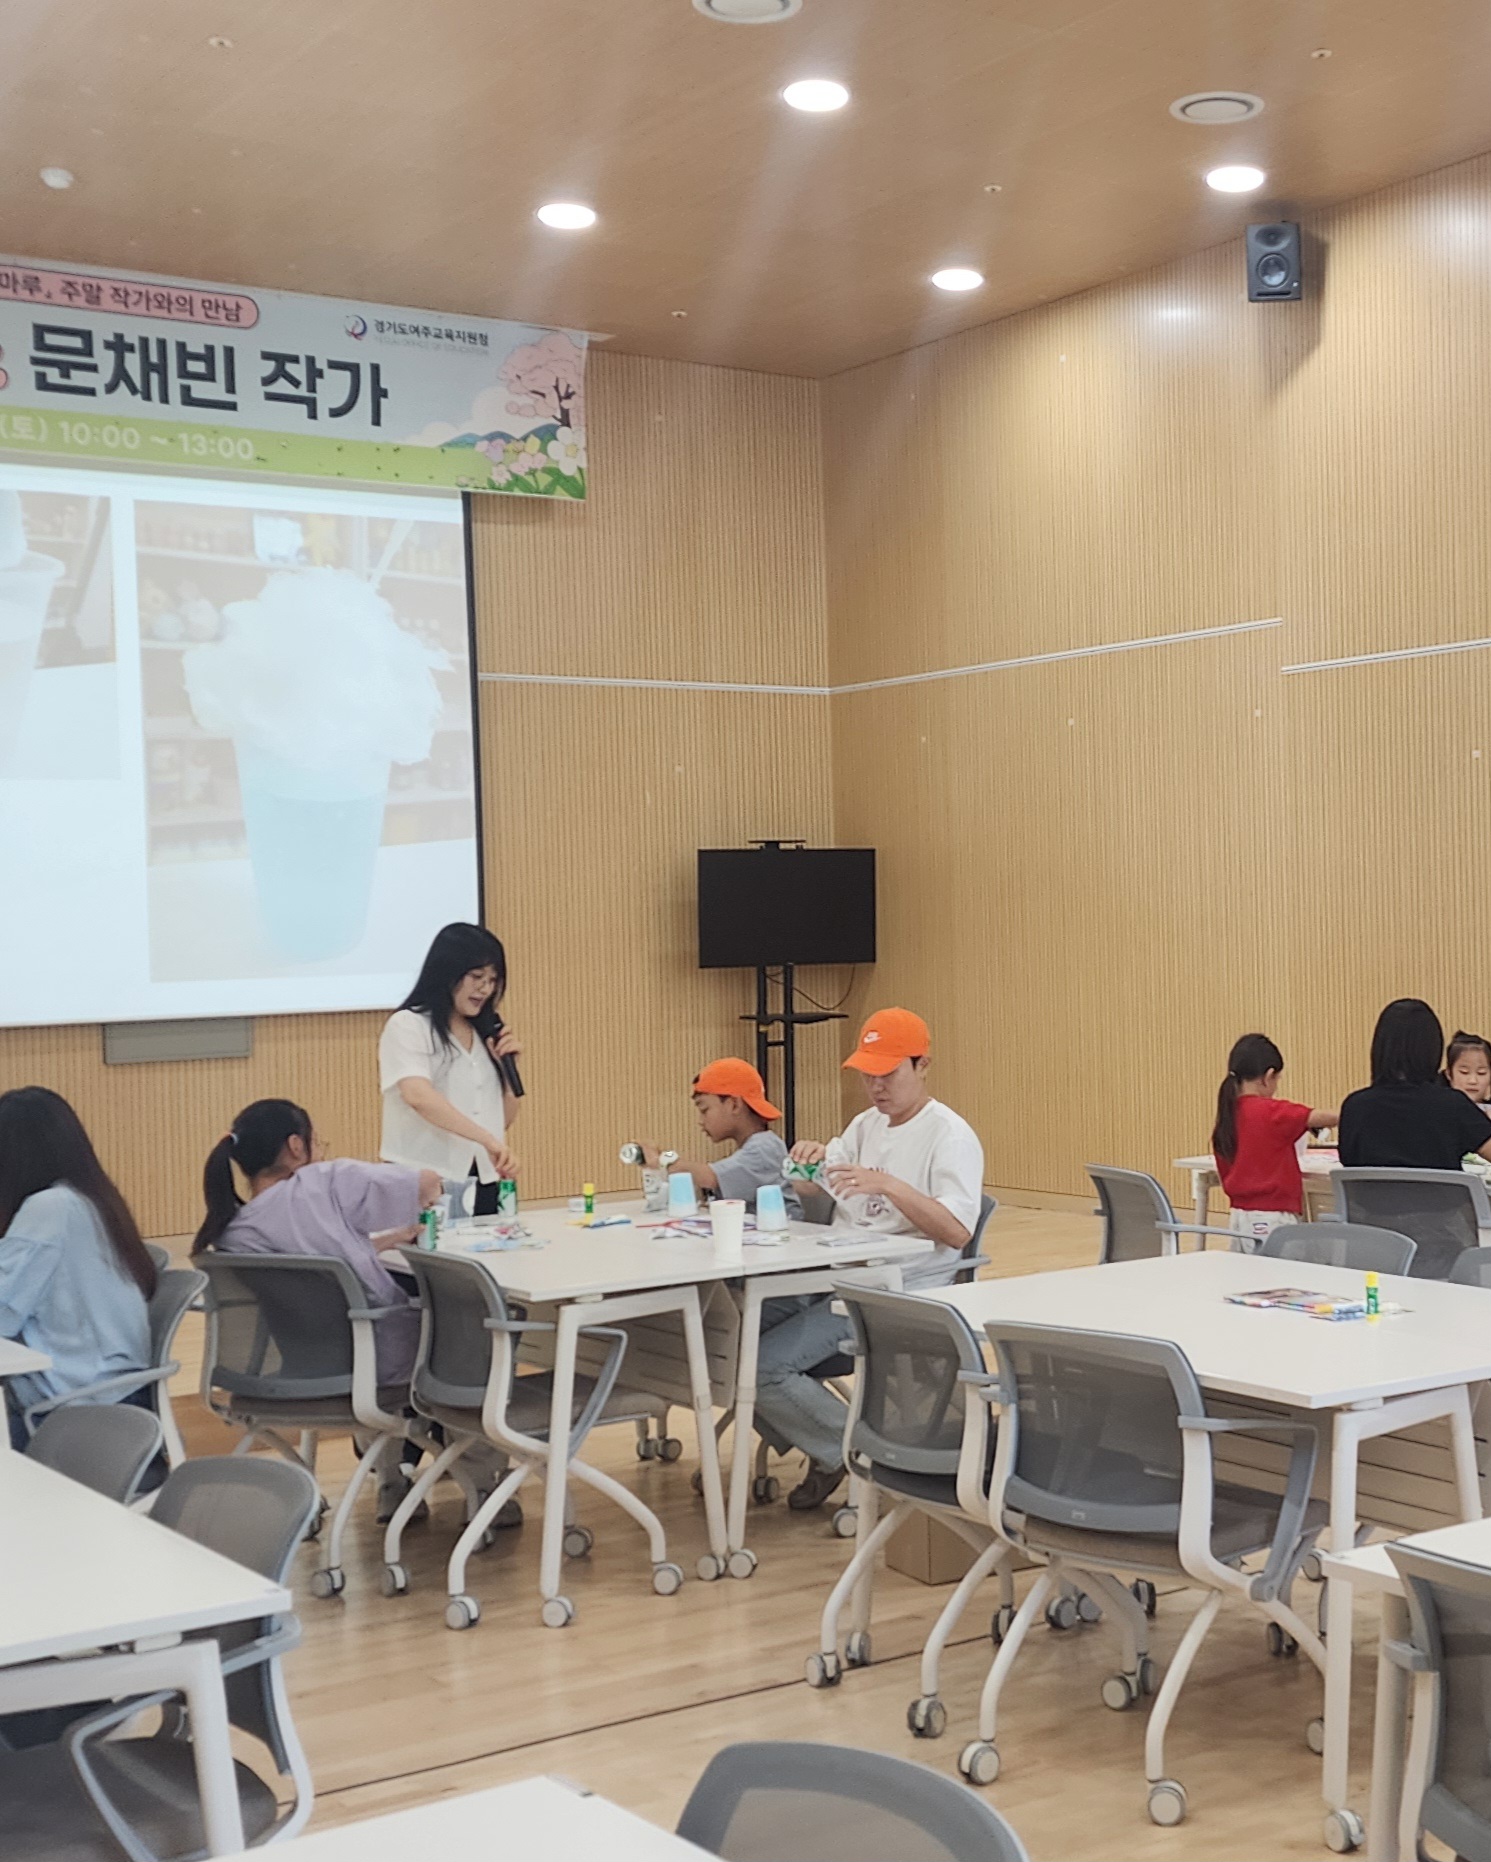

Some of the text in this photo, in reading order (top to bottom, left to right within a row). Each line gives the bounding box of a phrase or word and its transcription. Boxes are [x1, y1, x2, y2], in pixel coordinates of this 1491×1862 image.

[60, 280, 102, 306] 주말
[110, 286, 195, 317] 작가와의
[201, 299, 242, 323] 만남
[29, 321, 389, 427] 문채빈 작가
[58, 420, 141, 450] 10:00
[177, 432, 254, 460] 13:00
